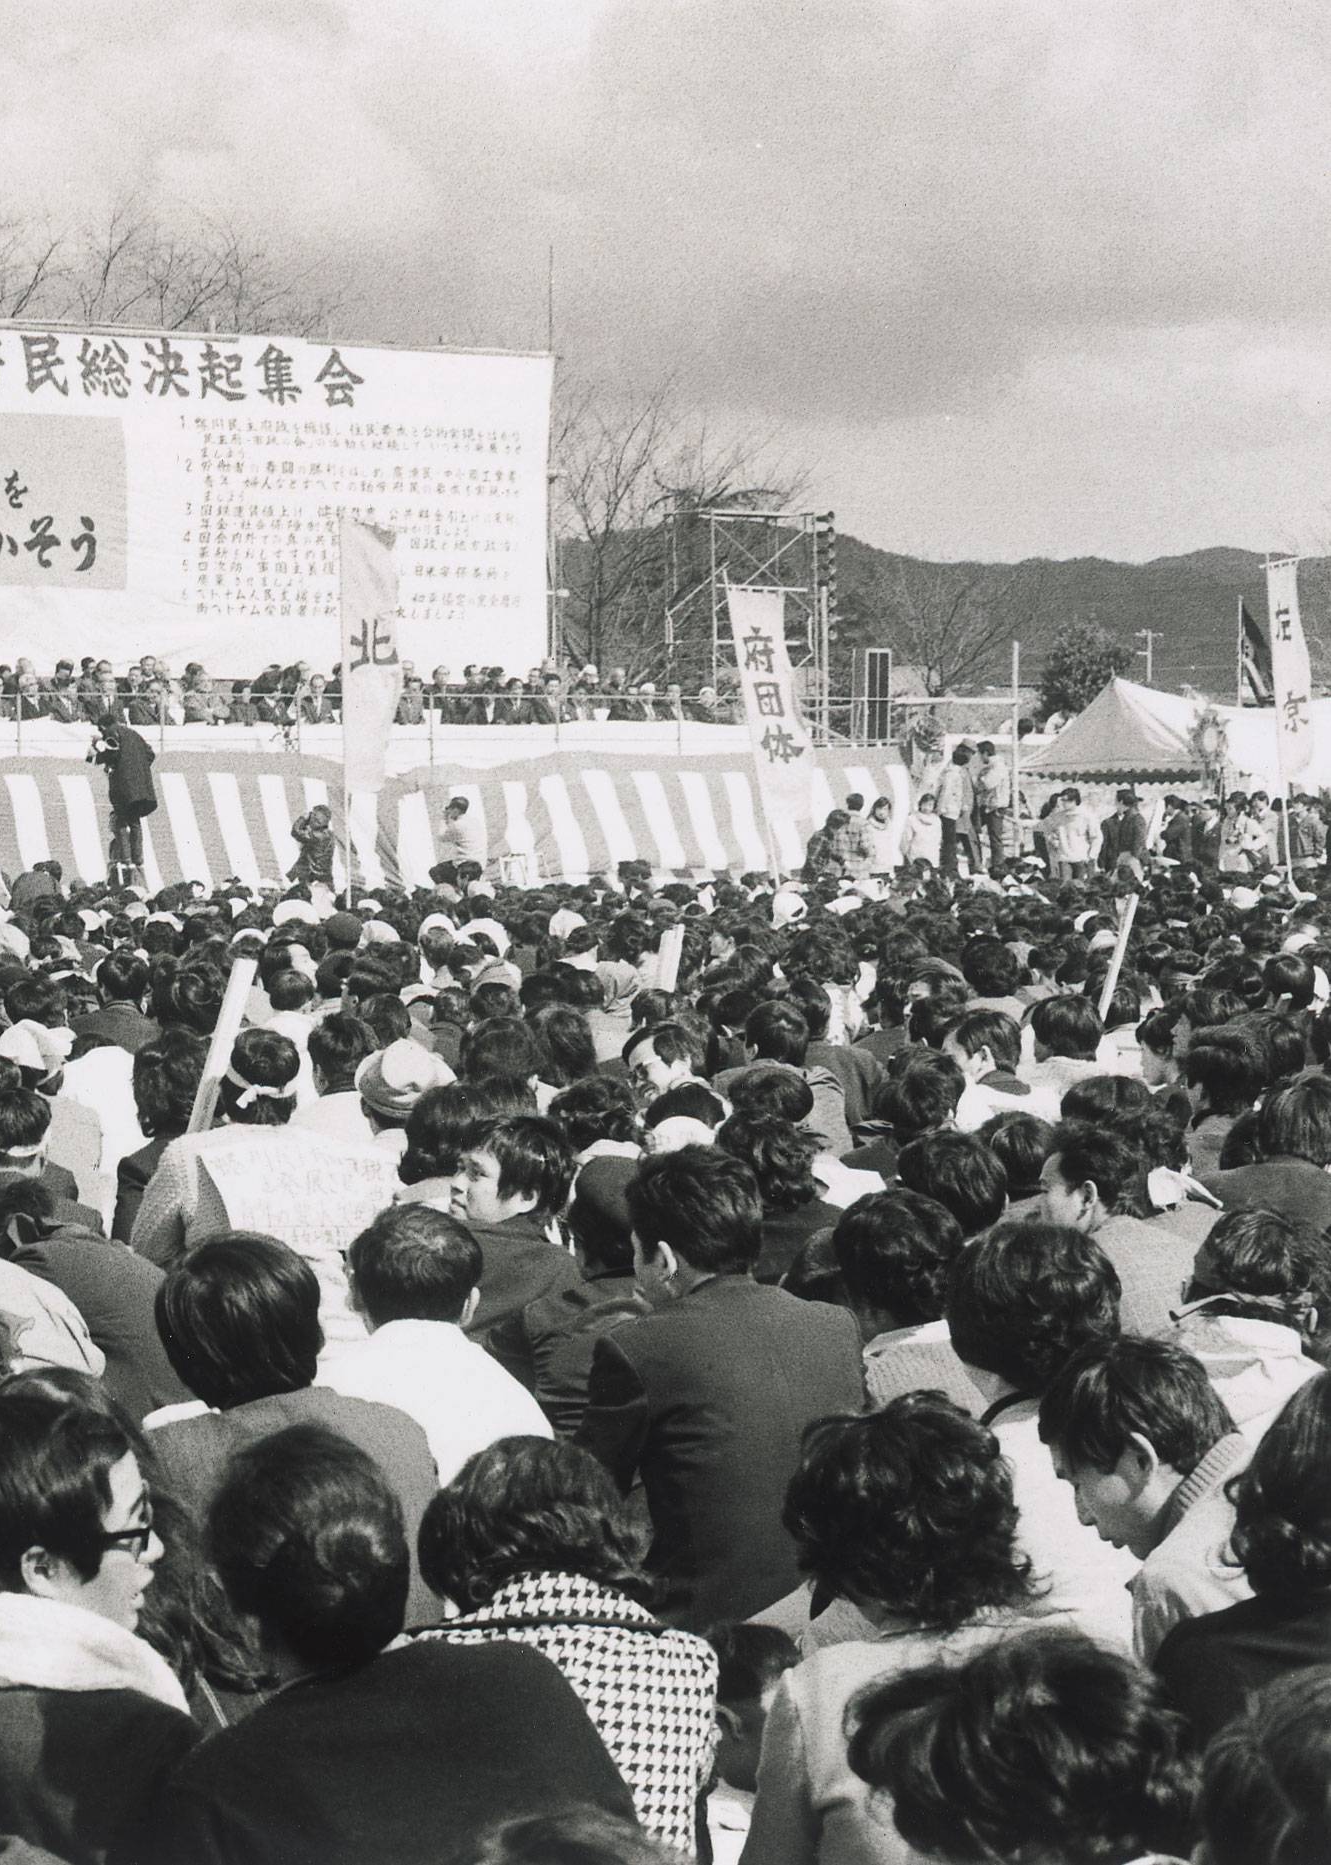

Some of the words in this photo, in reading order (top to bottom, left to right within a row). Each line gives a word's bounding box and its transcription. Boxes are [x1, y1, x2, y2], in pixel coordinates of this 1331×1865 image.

[349, 618, 398, 672] 北
[743, 626, 806, 764] 府団体
